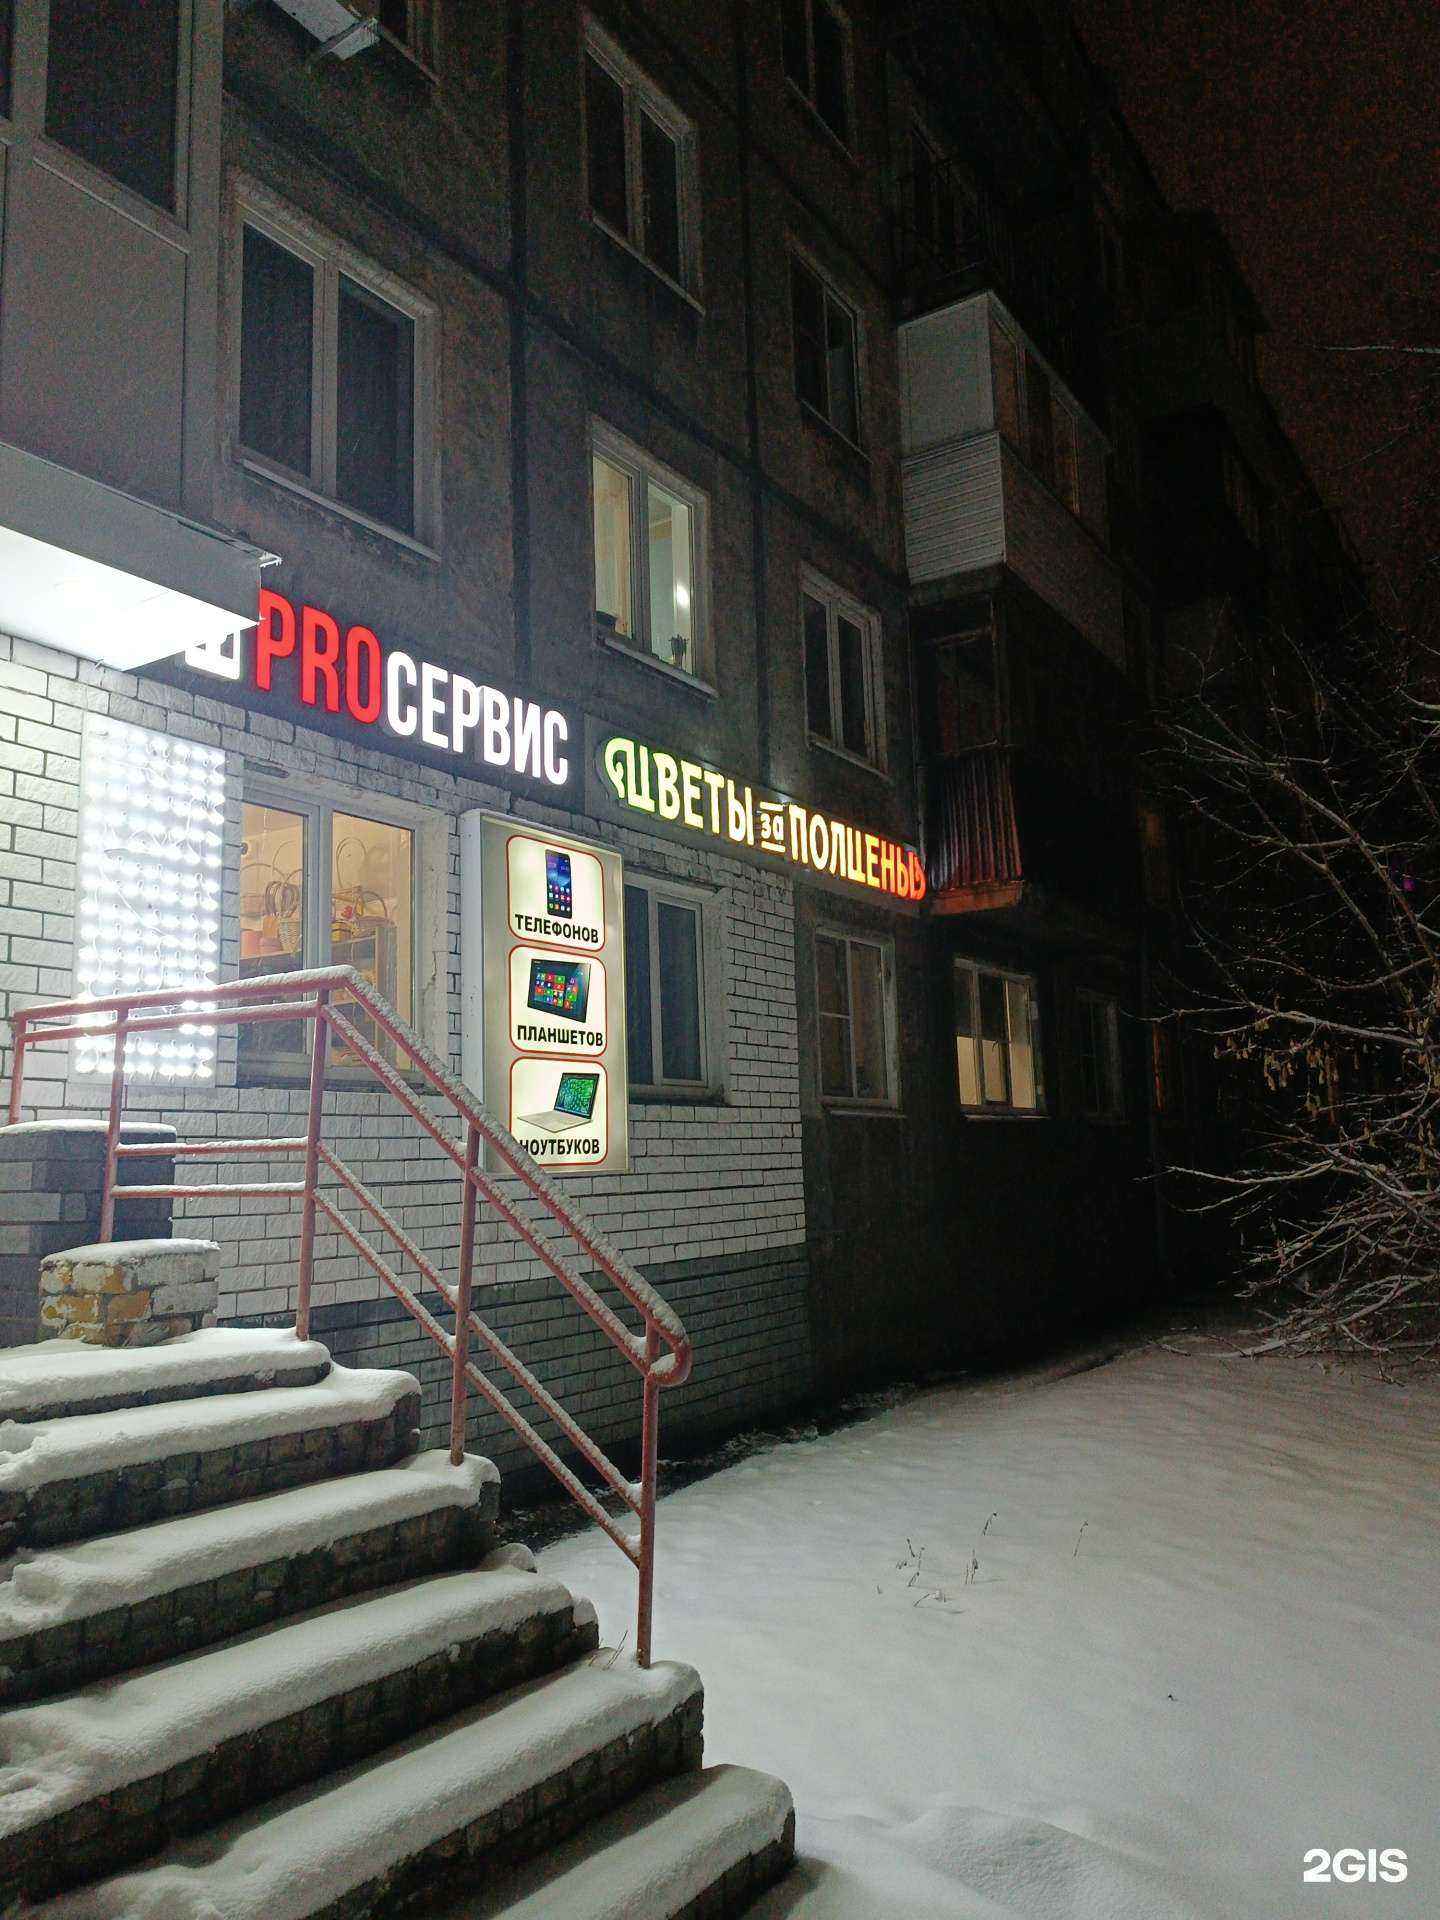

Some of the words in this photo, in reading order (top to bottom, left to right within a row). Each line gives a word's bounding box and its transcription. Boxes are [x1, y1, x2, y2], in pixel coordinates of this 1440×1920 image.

[604, 737, 754, 846] ЦВЕТЫ
[760, 813, 785, 842] за
[788, 804, 926, 900] ПОЛЦЕНЫ
[514, 913, 599, 943] ТЕЛЕФОНОВ
[516, 1024, 604, 1047] ПЛАНШЕТОВ
